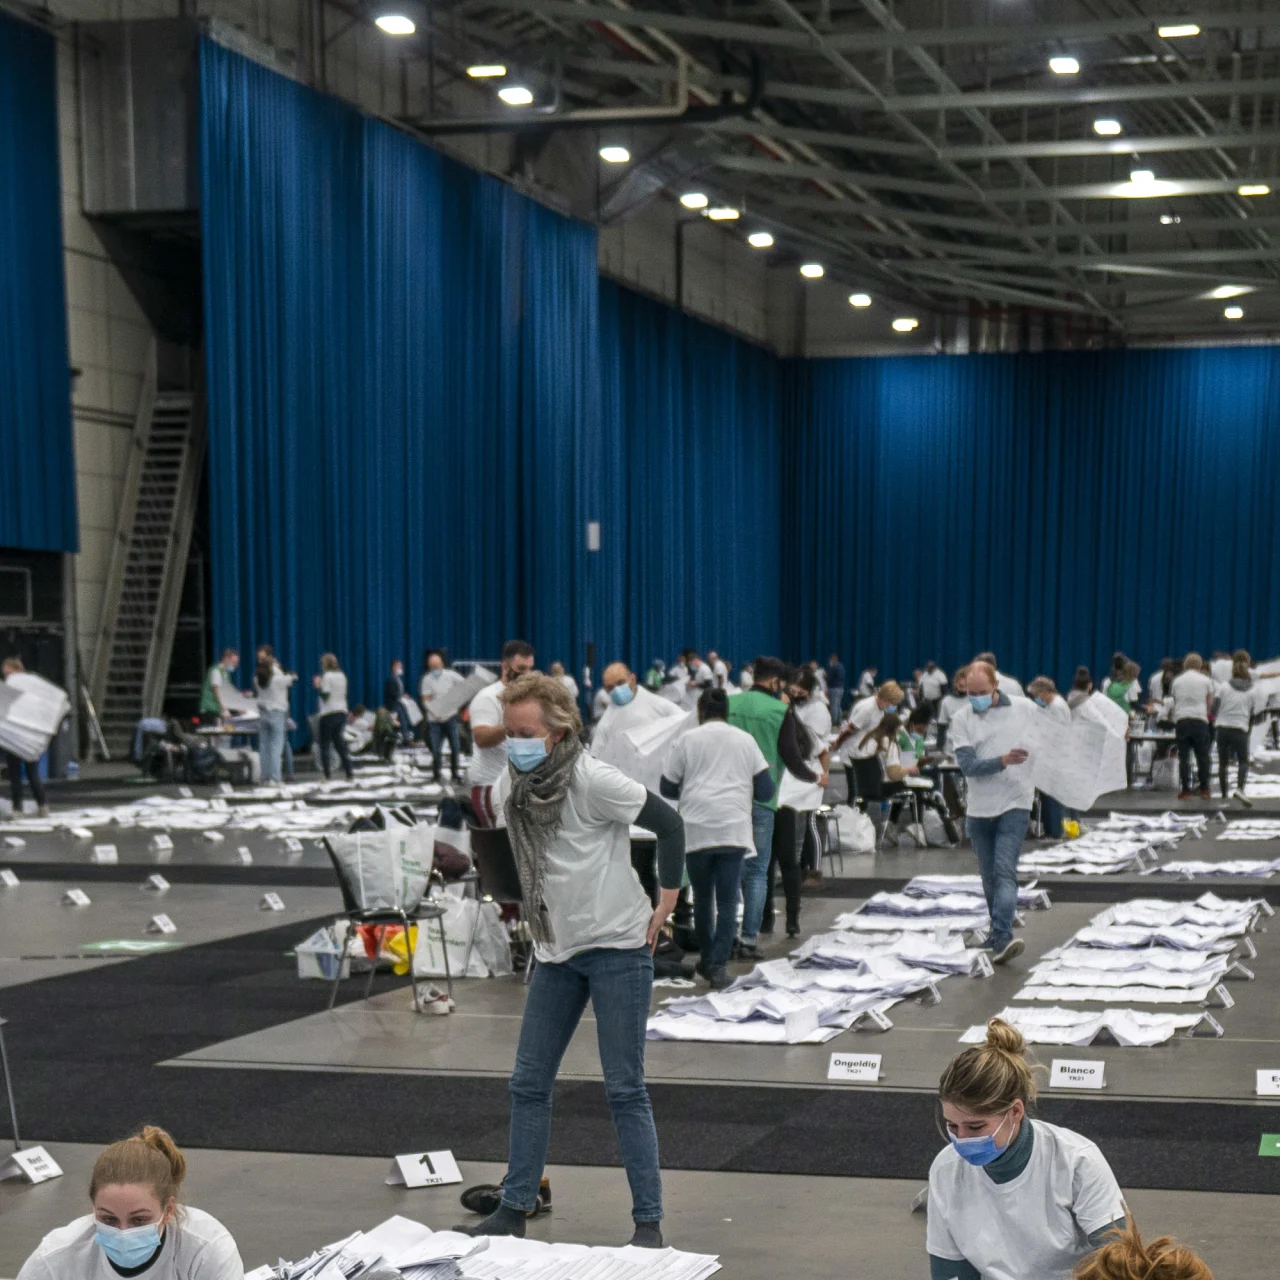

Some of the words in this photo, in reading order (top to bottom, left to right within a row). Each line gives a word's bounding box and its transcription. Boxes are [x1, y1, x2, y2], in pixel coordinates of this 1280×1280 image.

[833, 1059, 878, 1069] Ongeldig
[1059, 1066, 1096, 1075] Blanco
[418, 1154, 437, 1176] 1
[424, 1177, 444, 1185] TK21
